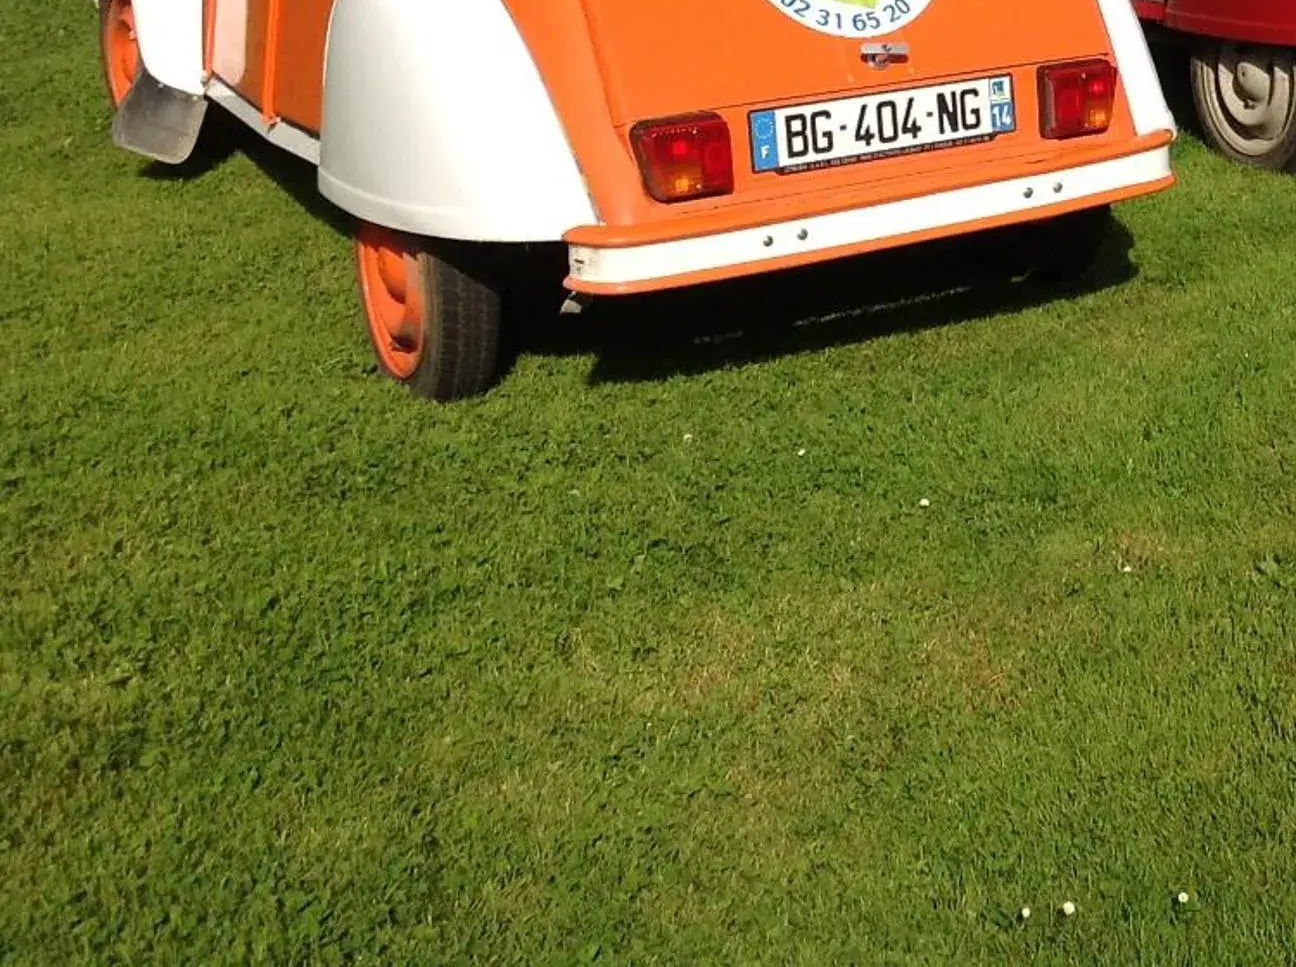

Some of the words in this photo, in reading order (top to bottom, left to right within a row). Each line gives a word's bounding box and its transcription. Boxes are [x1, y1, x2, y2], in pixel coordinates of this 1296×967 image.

[815, 9, 843, 29] 31
[852, 12, 881, 32] 65
[992, 104, 1012, 128] 14
[760, 144, 770, 160] F
